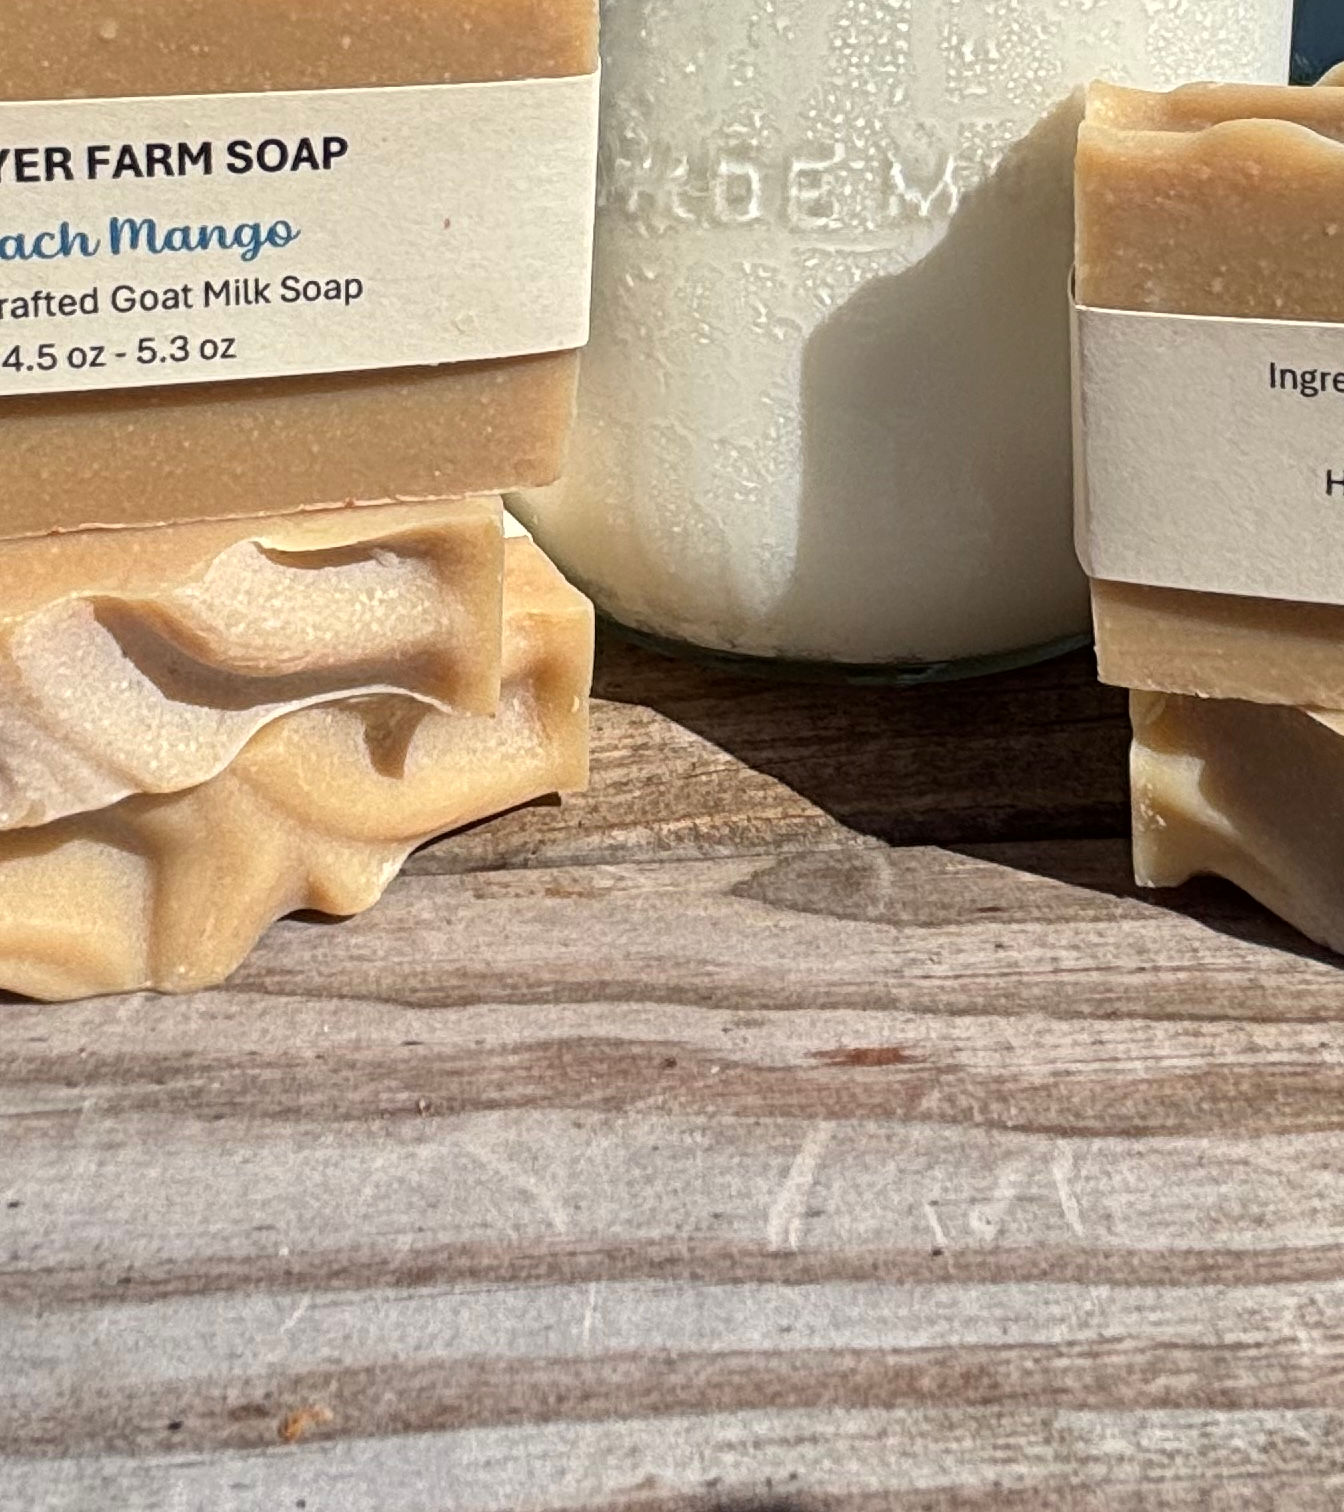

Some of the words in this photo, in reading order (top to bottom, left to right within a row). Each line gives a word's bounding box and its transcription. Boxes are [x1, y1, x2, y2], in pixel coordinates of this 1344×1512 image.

[85, 140, 214, 181] FARM
[225, 135, 350, 175] SOAP
[107, 215, 303, 264] Mango
[110, 282, 195, 315] Goat
[202, 276, 273, 310] Milk
[279, 273, 365, 308] Soap
[1, 342, 59, 374] 4.5
[65, 345, 108, 371] oz
[136, 334, 191, 366] 5.3
[197, 336, 239, 362] oz
